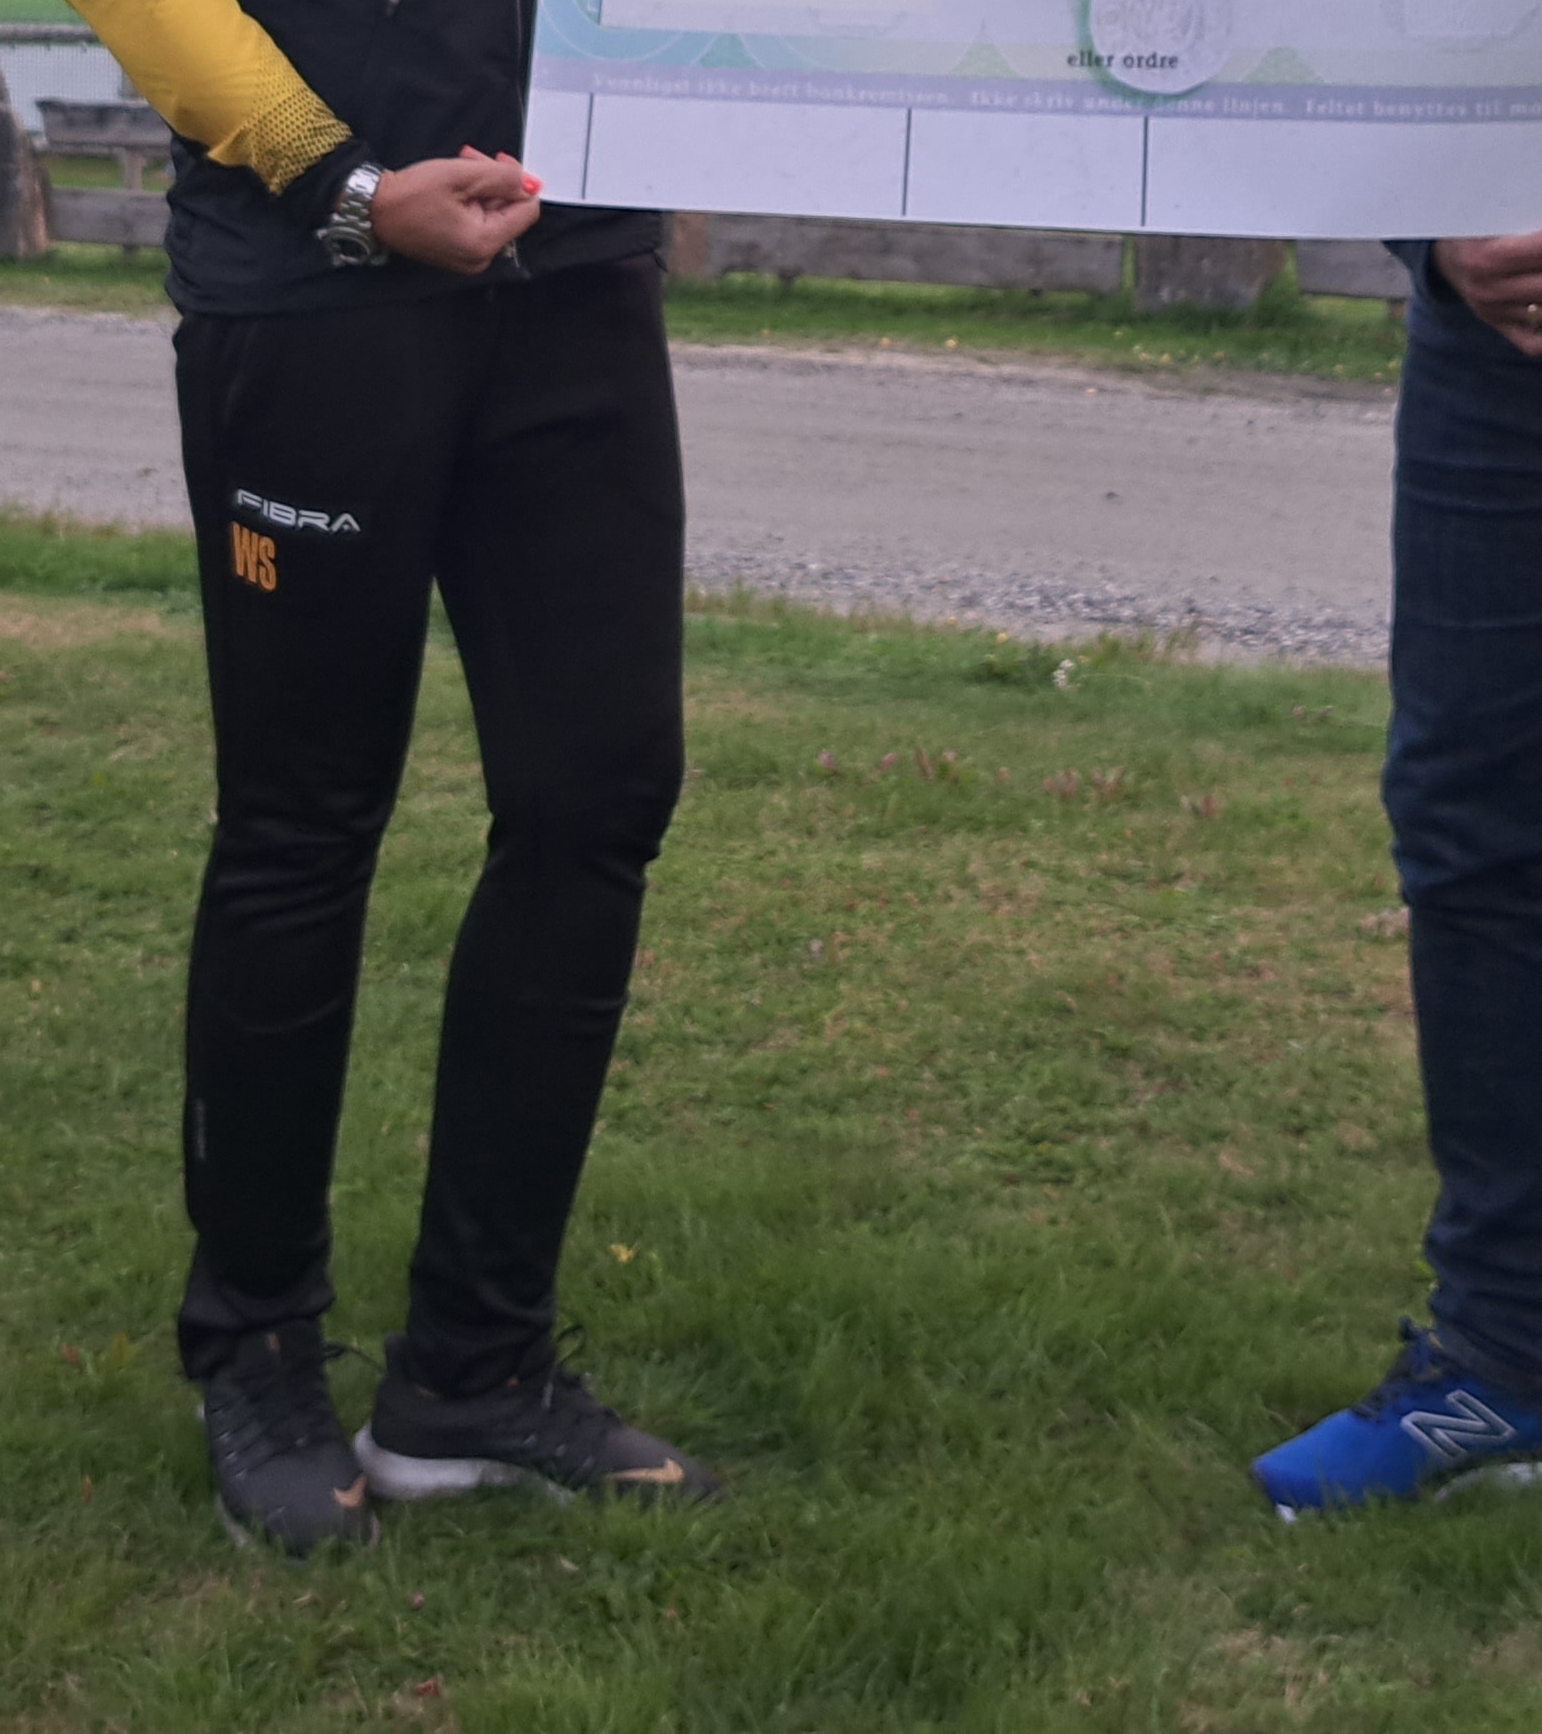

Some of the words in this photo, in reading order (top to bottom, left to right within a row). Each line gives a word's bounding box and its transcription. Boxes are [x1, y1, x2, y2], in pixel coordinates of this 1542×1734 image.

[1067, 50, 1115, 68] eller
[1123, 50, 1179, 68] ordre
[236, 488, 360, 533] FIBRA
[231, 521, 277, 592] WS
